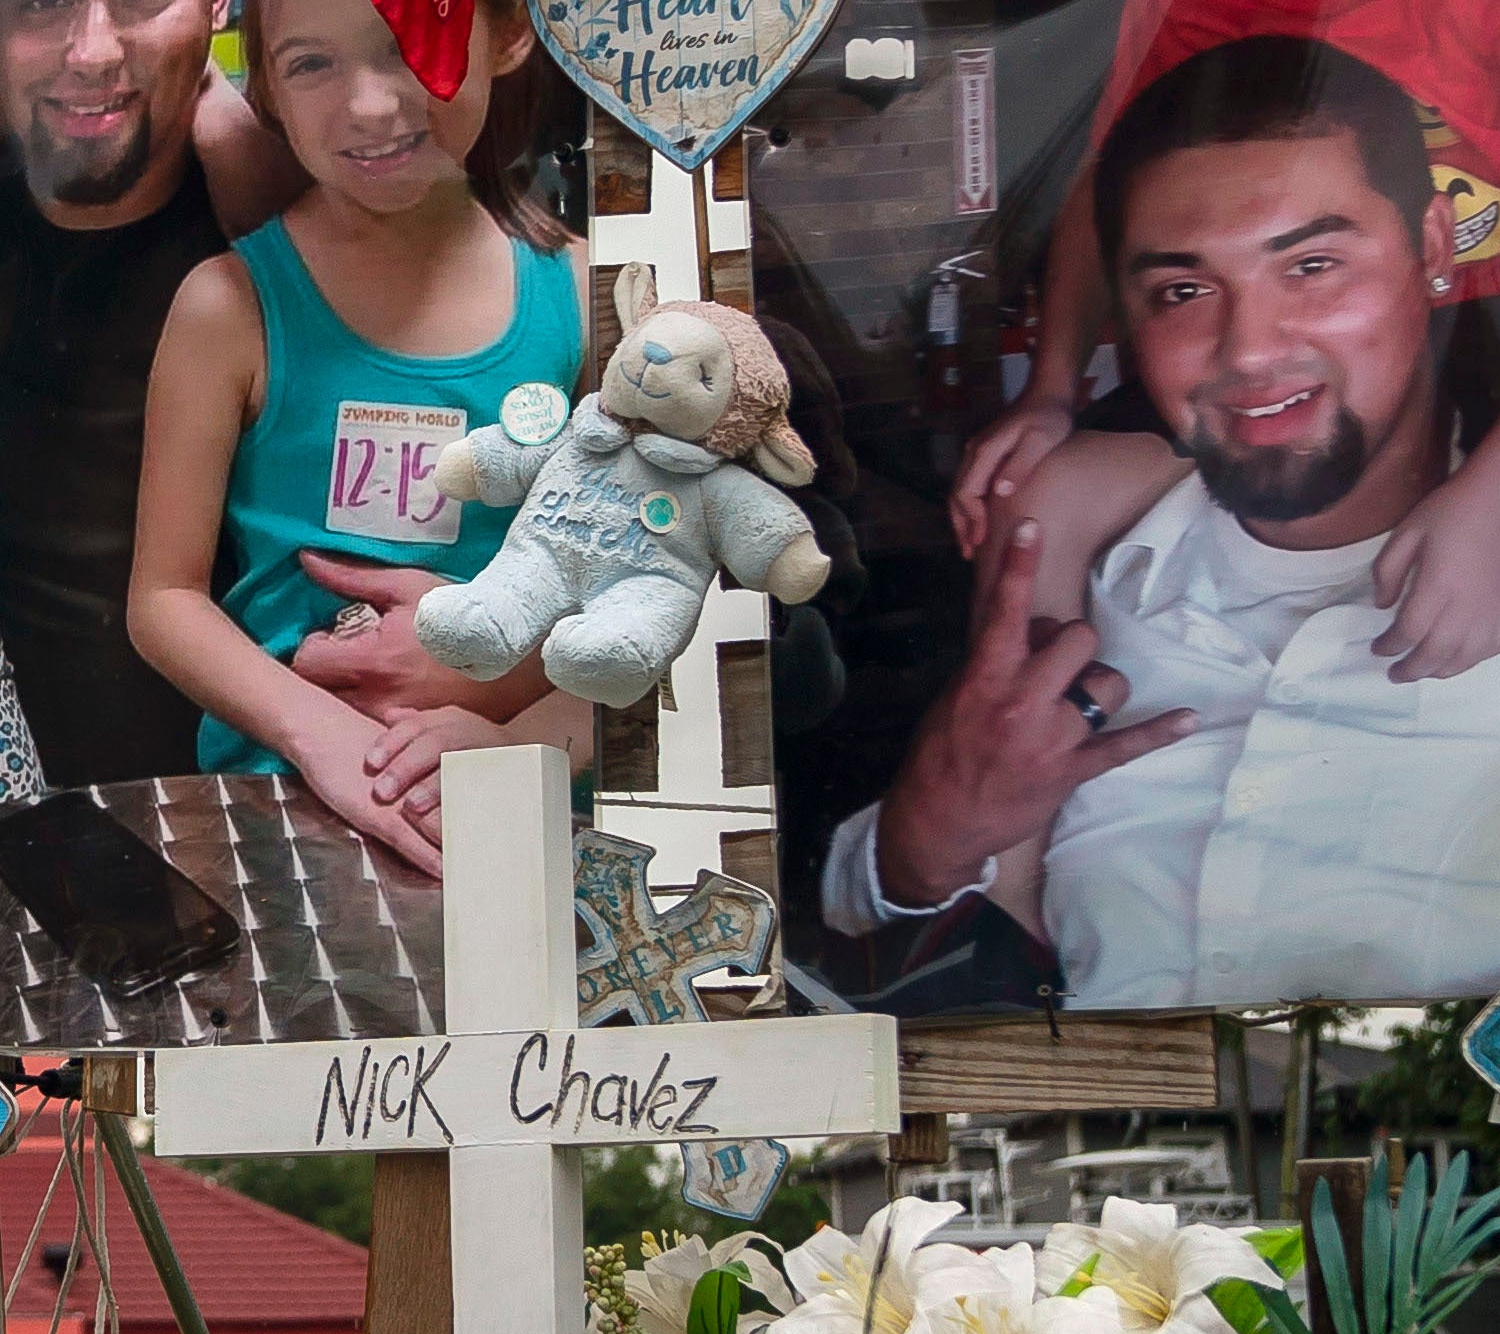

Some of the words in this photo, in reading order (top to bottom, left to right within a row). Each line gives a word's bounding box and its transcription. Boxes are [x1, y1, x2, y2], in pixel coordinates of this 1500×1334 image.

[614, 50, 761, 107] Heaven
[659, 30, 706, 51] lives
[713, 26, 740, 45] in
[332, 438, 447, 524] 12:15
[576, 913, 742, 1004] OREVER
[316, 1039, 454, 1146] NICK
[508, 1031, 722, 1135] Chavez
